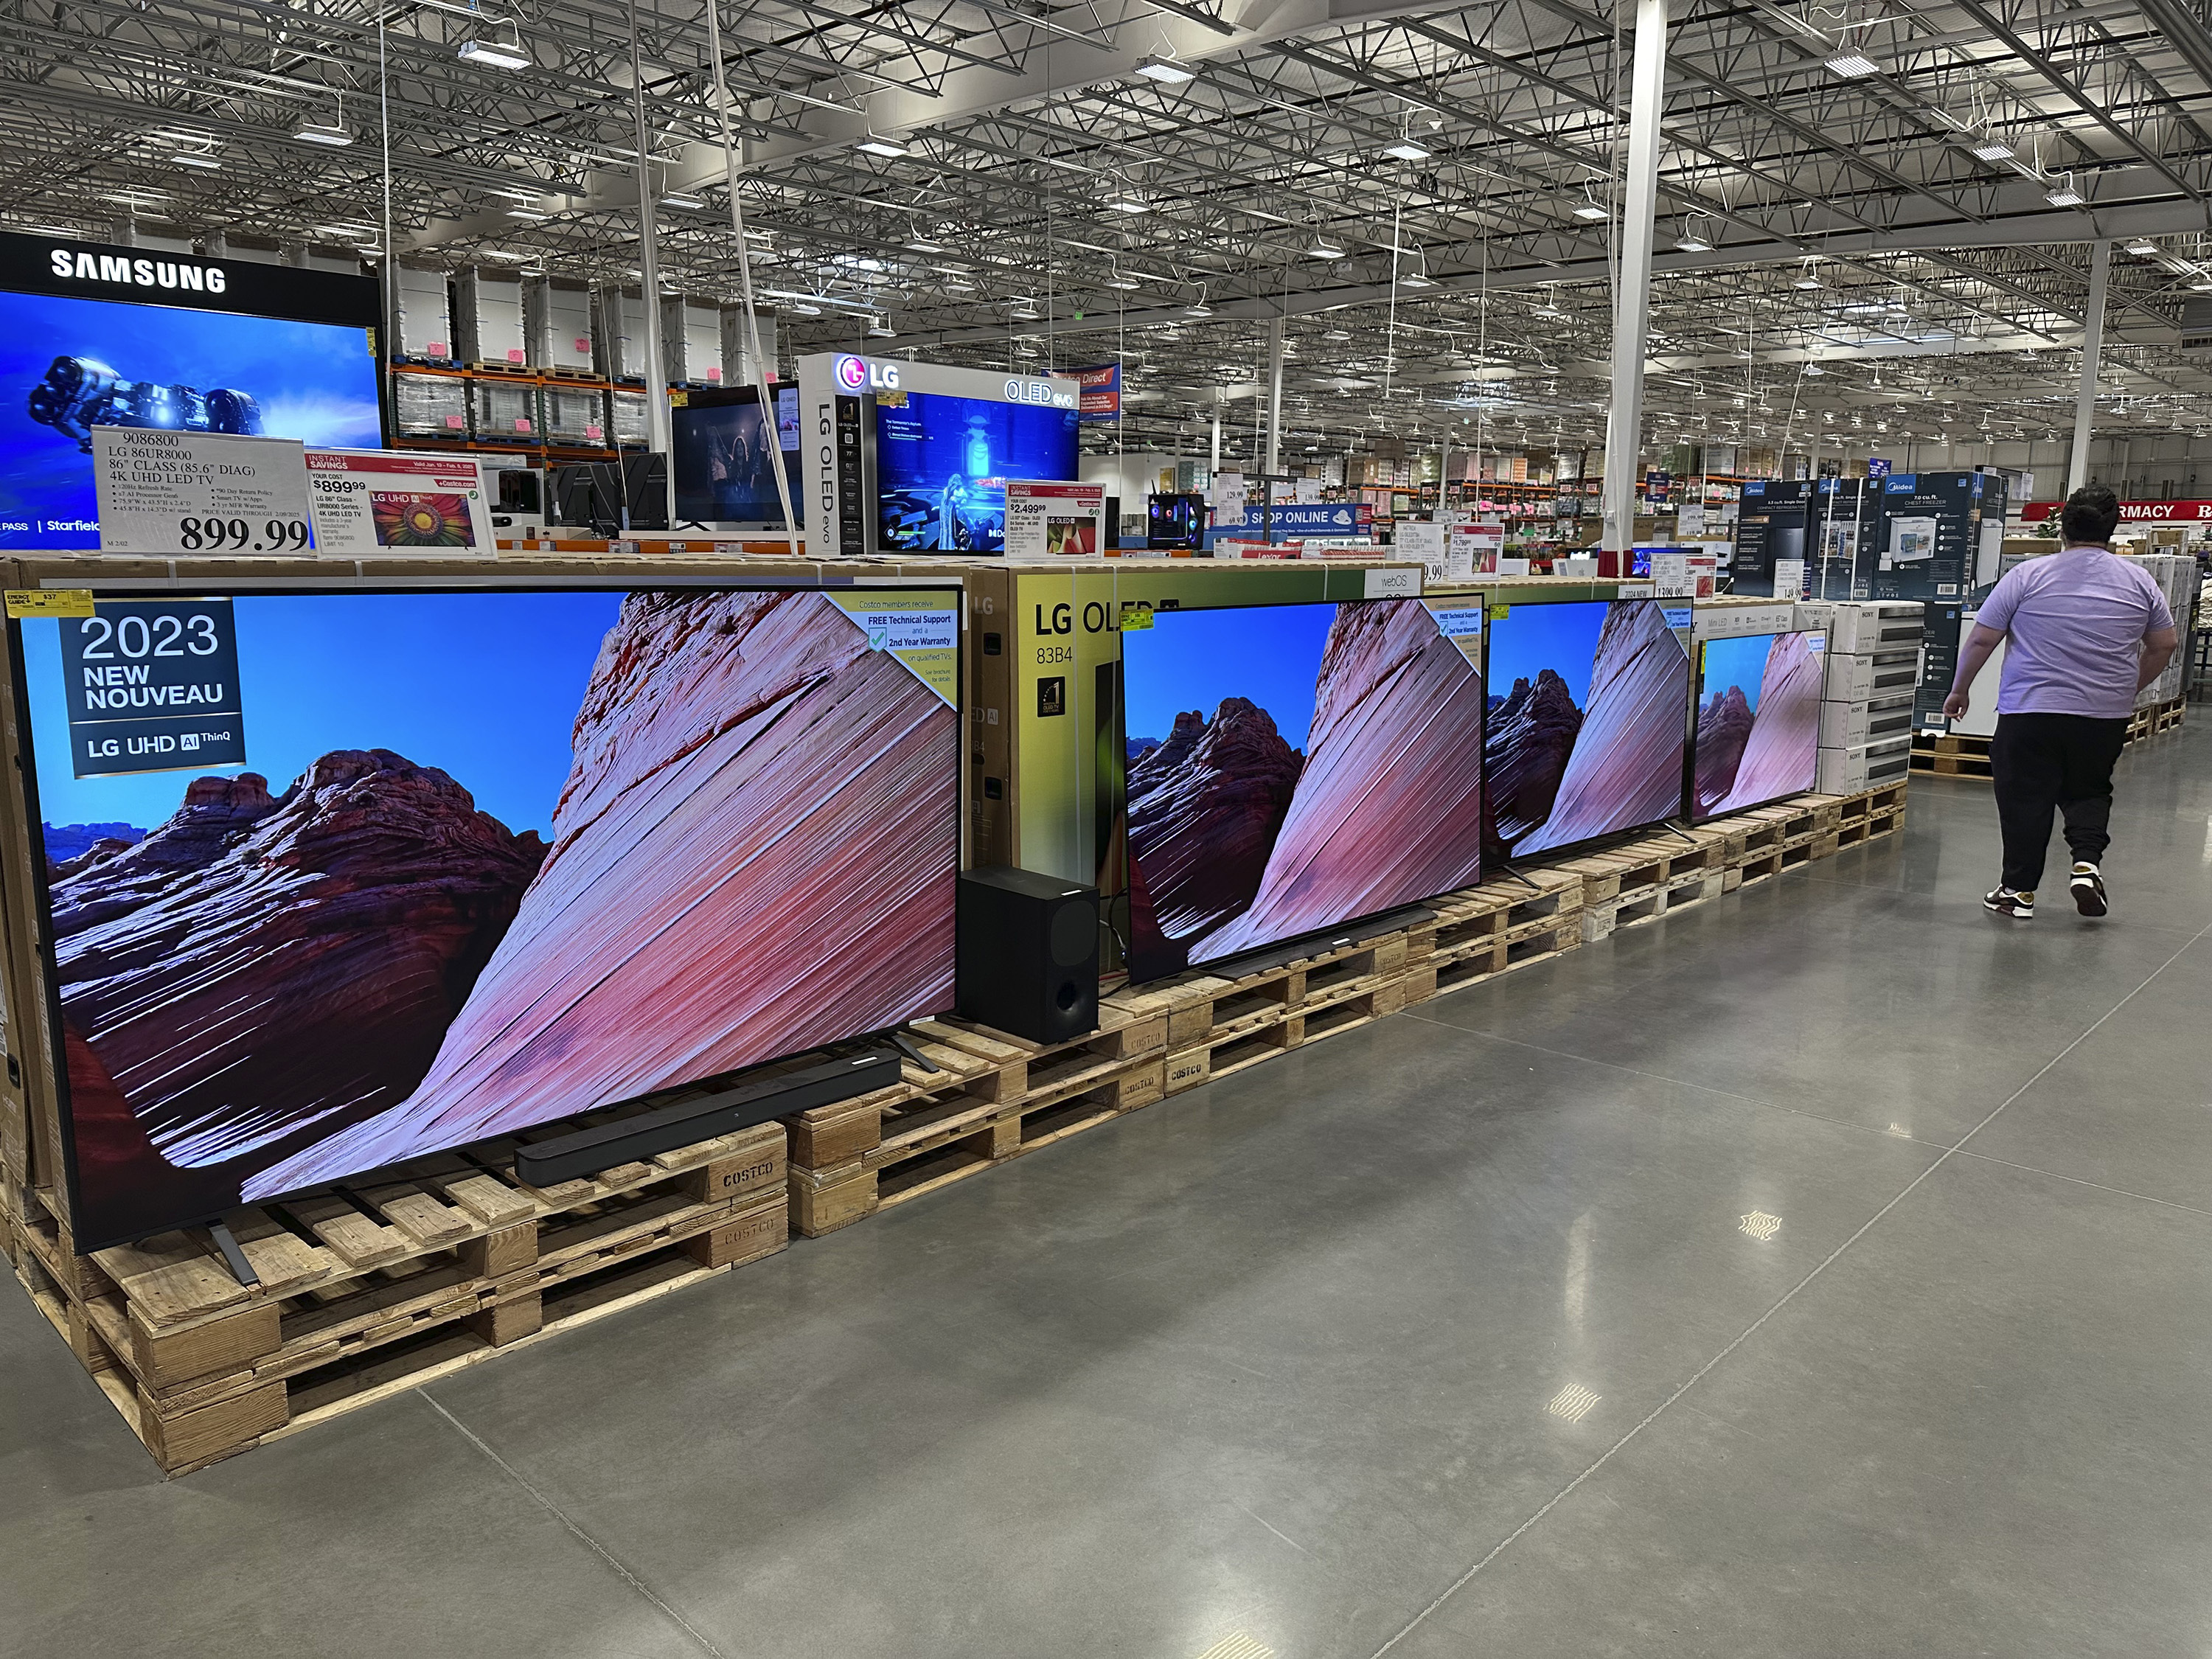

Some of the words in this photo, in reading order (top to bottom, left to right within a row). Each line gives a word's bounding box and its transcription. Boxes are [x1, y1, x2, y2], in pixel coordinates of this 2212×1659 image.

[51, 249, 226, 293] SAMSUNG
[869, 364, 900, 389] LG
[1082, 372, 1106, 383] Direct
[1004, 379, 1052, 405] OLED
[818, 403, 831, 436] LG
[123, 432, 178, 447] 9086800
[108, 446, 127, 457] LG
[132, 448, 192, 460] 86UR8000
[309, 454, 347, 462] INSTANT
[109, 459, 128, 469] 86"
[134, 459, 176, 472] CLASS
[181, 462, 215, 474] (85.6"
[219, 464, 256, 478] DIAG)
[310, 461, 348, 470] SAVINGS
[110, 471, 127, 481] 4K
[132, 472, 162, 483] UHD
[167, 473, 192, 484] LED
[196, 474, 214, 485] TV
[820, 445, 833, 512] OLED
[1226, 491, 1243, 499] 129.99
[1888, 482, 1913, 492] Midea
[372, 493, 385, 501] LG
[388, 494, 409, 502] UHD
[1285, 511, 1329, 523] ONLINE
[2118, 505, 2175, 518] RMACY
[1, 522, 29, 531] PASS
[180, 517, 308, 552] 899.99
[1381, 575, 1407, 587] webOS
[1424, 565, 1442, 581] 9.99
[859, 600, 881, 608] Costco
[882, 600, 911, 608] members
[974, 597, 993, 615] LG
[868, 616, 887, 625] FREE
[888, 616, 922, 625] Technical
[923, 615, 950, 625] Support
[1035, 602, 1071, 636] LG
[1083, 601, 1153, 633] OL
[80, 614, 218, 659] 2023
[888, 639, 902, 647] 2nd
[903, 638, 919, 646] Year
[919, 637, 950, 646] Warranty
[917, 653, 940, 662] qualified
[1037, 647, 1072, 664] 83B4
[83, 665, 150, 687] NEW
[86, 684, 223, 709] NOUVEAU
[88, 739, 119, 758] LG
[127, 735, 175, 754] UHD
[201, 731, 230, 742] ThinQ
[1130, 1032, 1161, 1049] COSTCO
[1171, 1064, 1201, 1081] COSTCO
[1124, 1077, 1154, 1095] COSTCO
[723, 1161, 773, 1187] COSTCO
[725, 1218, 773, 1245] COSTCO
